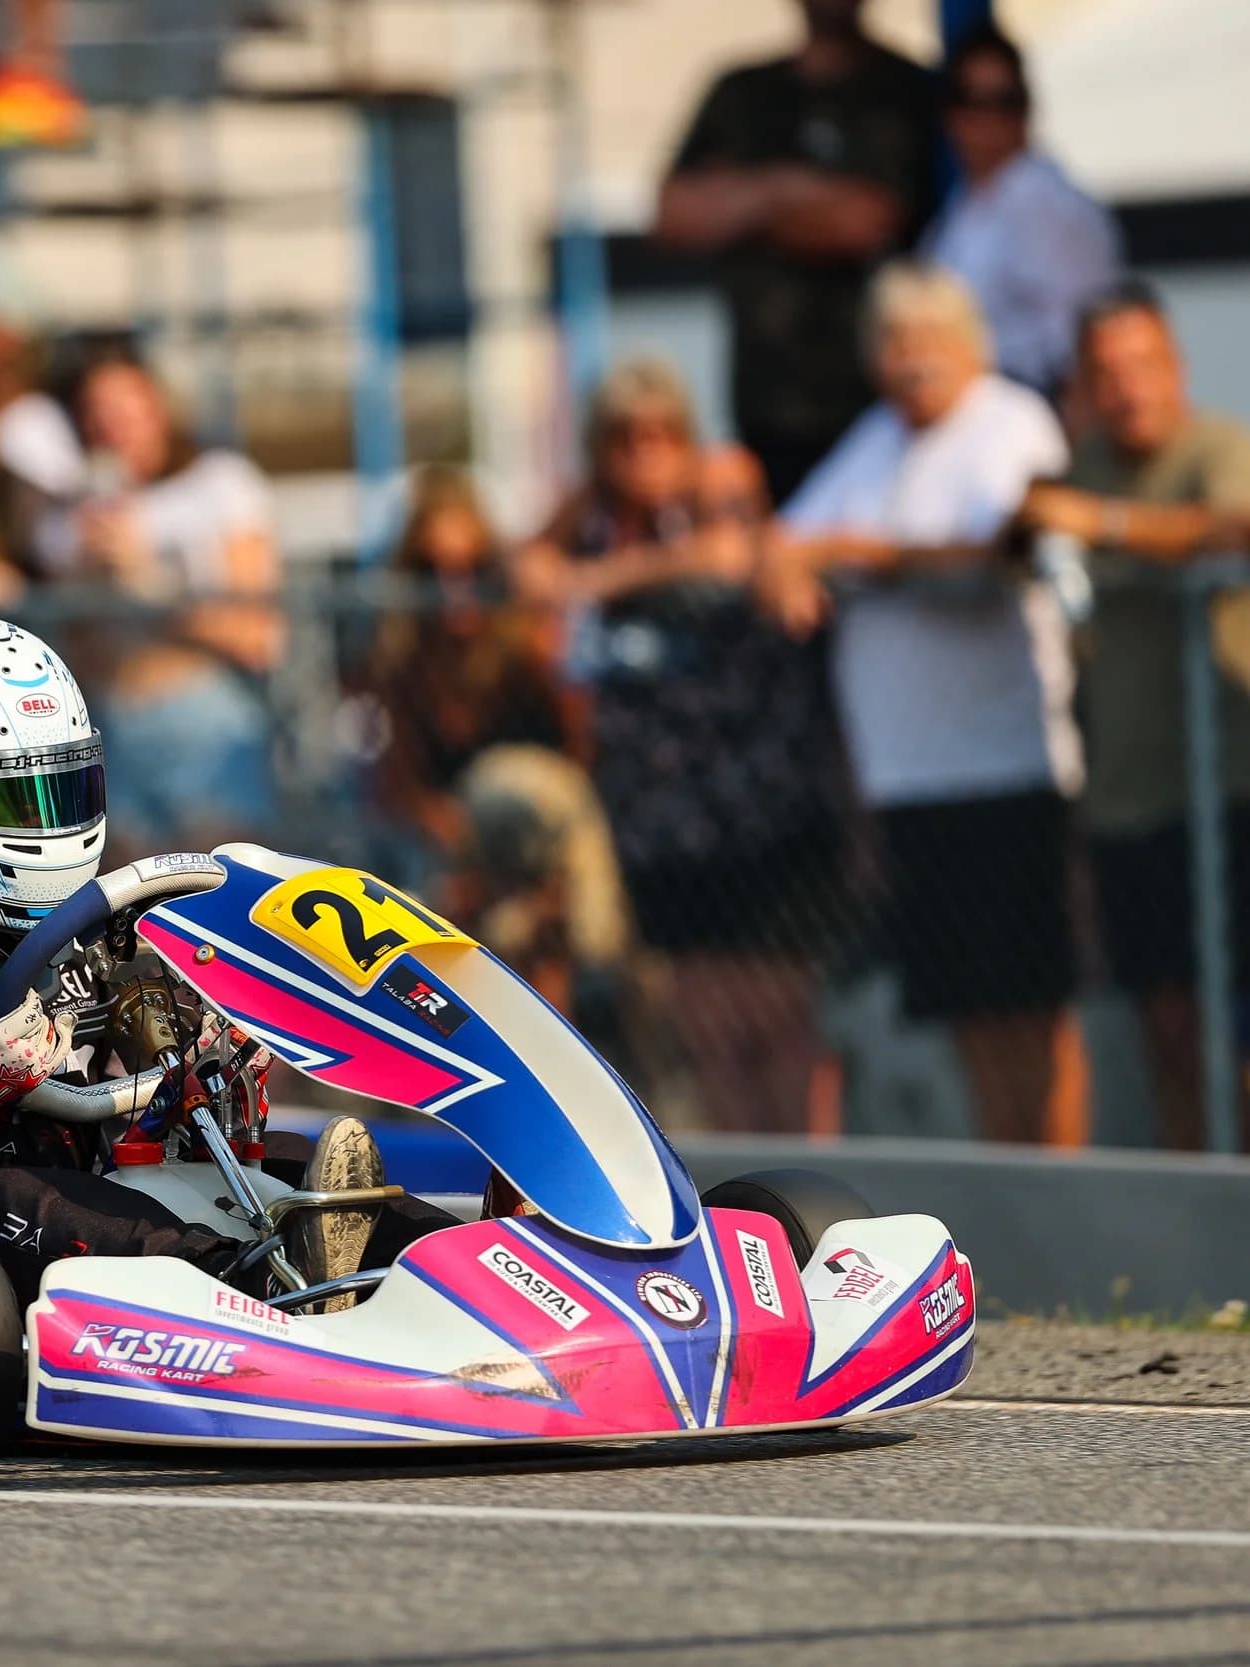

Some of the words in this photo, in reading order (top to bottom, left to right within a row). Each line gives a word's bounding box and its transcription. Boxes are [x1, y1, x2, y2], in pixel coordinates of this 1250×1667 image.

[22, 699, 55, 711] BELL
[292, 877, 456, 973] 21
[493, 1251, 576, 1320] COASTAL
[743, 1240, 773, 1307] COASTAL
[832, 1265, 885, 1300] FEIGEL
[216, 1291, 290, 1325] FEIGEL
[73, 1323, 246, 1375] KOSMIC
[97, 1360, 156, 1376] RACING
[161, 1369, 206, 1383] KART
